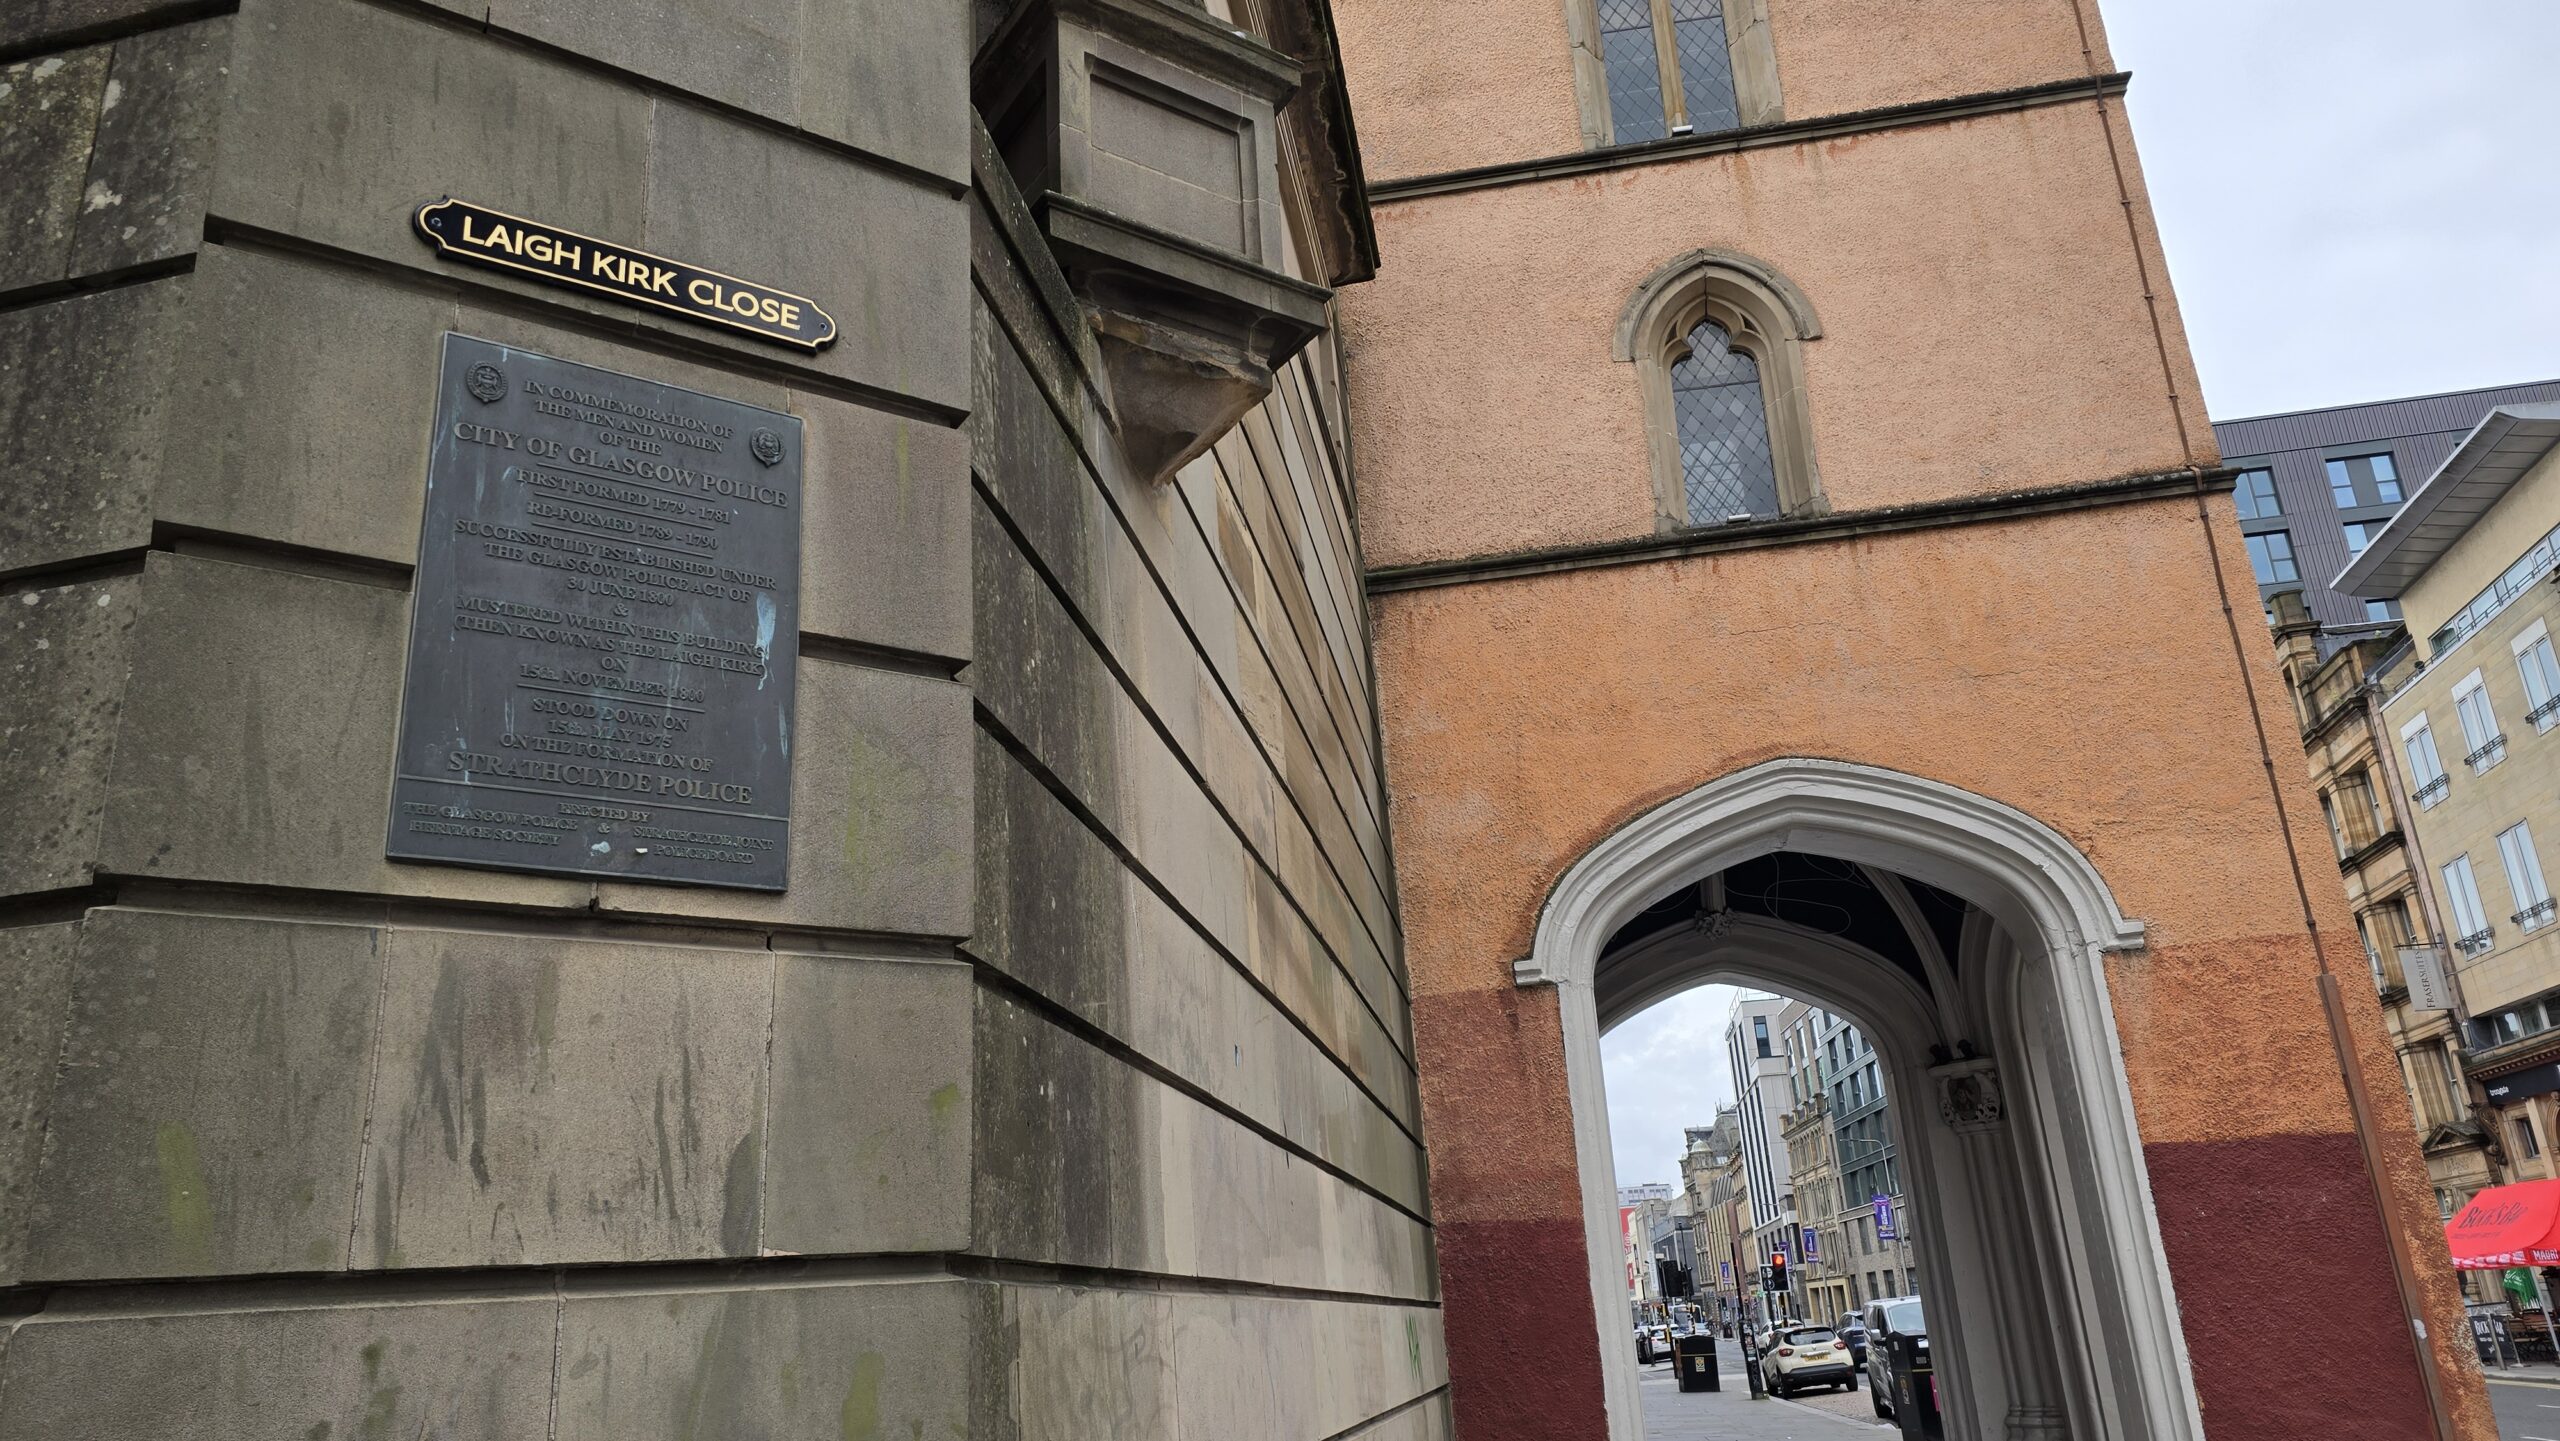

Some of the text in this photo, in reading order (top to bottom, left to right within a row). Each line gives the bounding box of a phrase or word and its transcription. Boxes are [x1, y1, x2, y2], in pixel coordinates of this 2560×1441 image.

[462, 215, 801, 331] LAIGH KIRK CLOSE
[525, 380, 734, 438] IN COMMEMORATION OF
[535, 400, 724, 454] THE MEN AND WOMEN
[600, 431, 662, 455] OF THE
[454, 422, 788, 507] CITY OF GLASGOW POLICE
[517, 468, 570, 491] FIRST
[573, 480, 650, 507] FORMED
[654, 498, 686, 515] 1779
[699, 506, 730, 524] 1781
[527, 502, 636, 533] RE-FORMED
[639, 523, 673, 540] 1789
[686, 532, 718, 550] 1790
[454, 518, 777, 591] SUCCESSFULLY ESTABLISHED UNDER
[485, 543, 752, 602] THE GLASGOW POLICE ACT OF
[589, 580, 637, 601] JUNE
[614, 603, 629, 617] &
[454, 615, 767, 679] (THEN KNOWN AS THE LAIGH KIRK)
[456, 596, 767, 659] MUSTERED WITHIN THIS BUILDING
[602, 656, 629, 673] ON
[563, 671, 668, 698] NOVEMBER
[671, 686, 704, 703] 1800
[533, 698, 690, 732] STOOD DOWN ON
[591, 722, 636, 744] MAY
[638, 731, 673, 749] 1975
[500, 733, 713, 774] ON THE FORMATION OF
[447, 751, 753, 805] STRATHCLYDE POLICE
[402, 801, 578, 831] THE GLASGOW POLICE
[409, 820, 562, 847] HERITAGE SOCIETY
[558, 803, 652, 823] ERECTED BY
[633, 825, 775, 850] STRATHCLYDE JOINT
